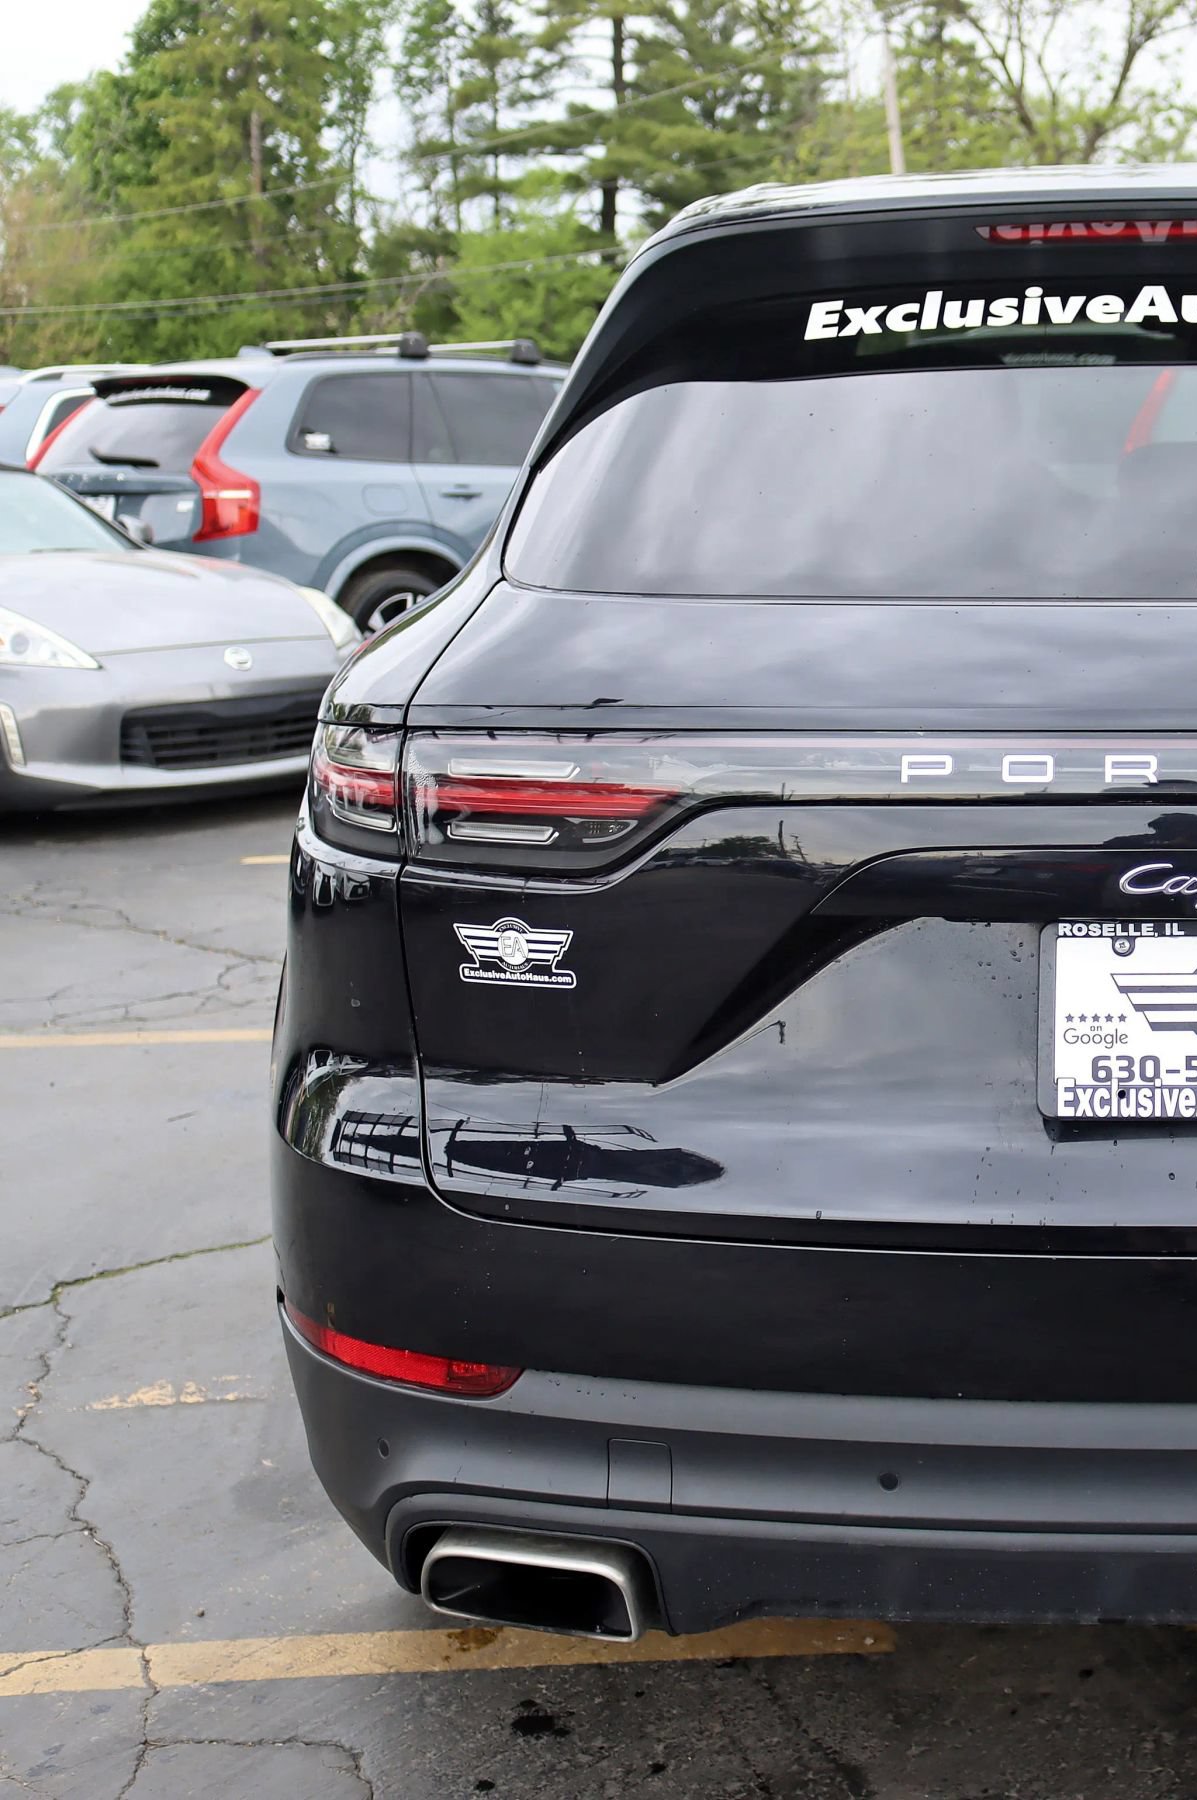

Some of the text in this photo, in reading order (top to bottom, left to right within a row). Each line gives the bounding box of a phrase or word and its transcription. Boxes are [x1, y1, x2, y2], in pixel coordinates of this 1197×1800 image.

[1058, 922, 1185, 938] ROSELLE, IL
[463, 967, 572, 984] ExclusiveAutoHaus.com
[1063, 1027, 1129, 1050] Google
